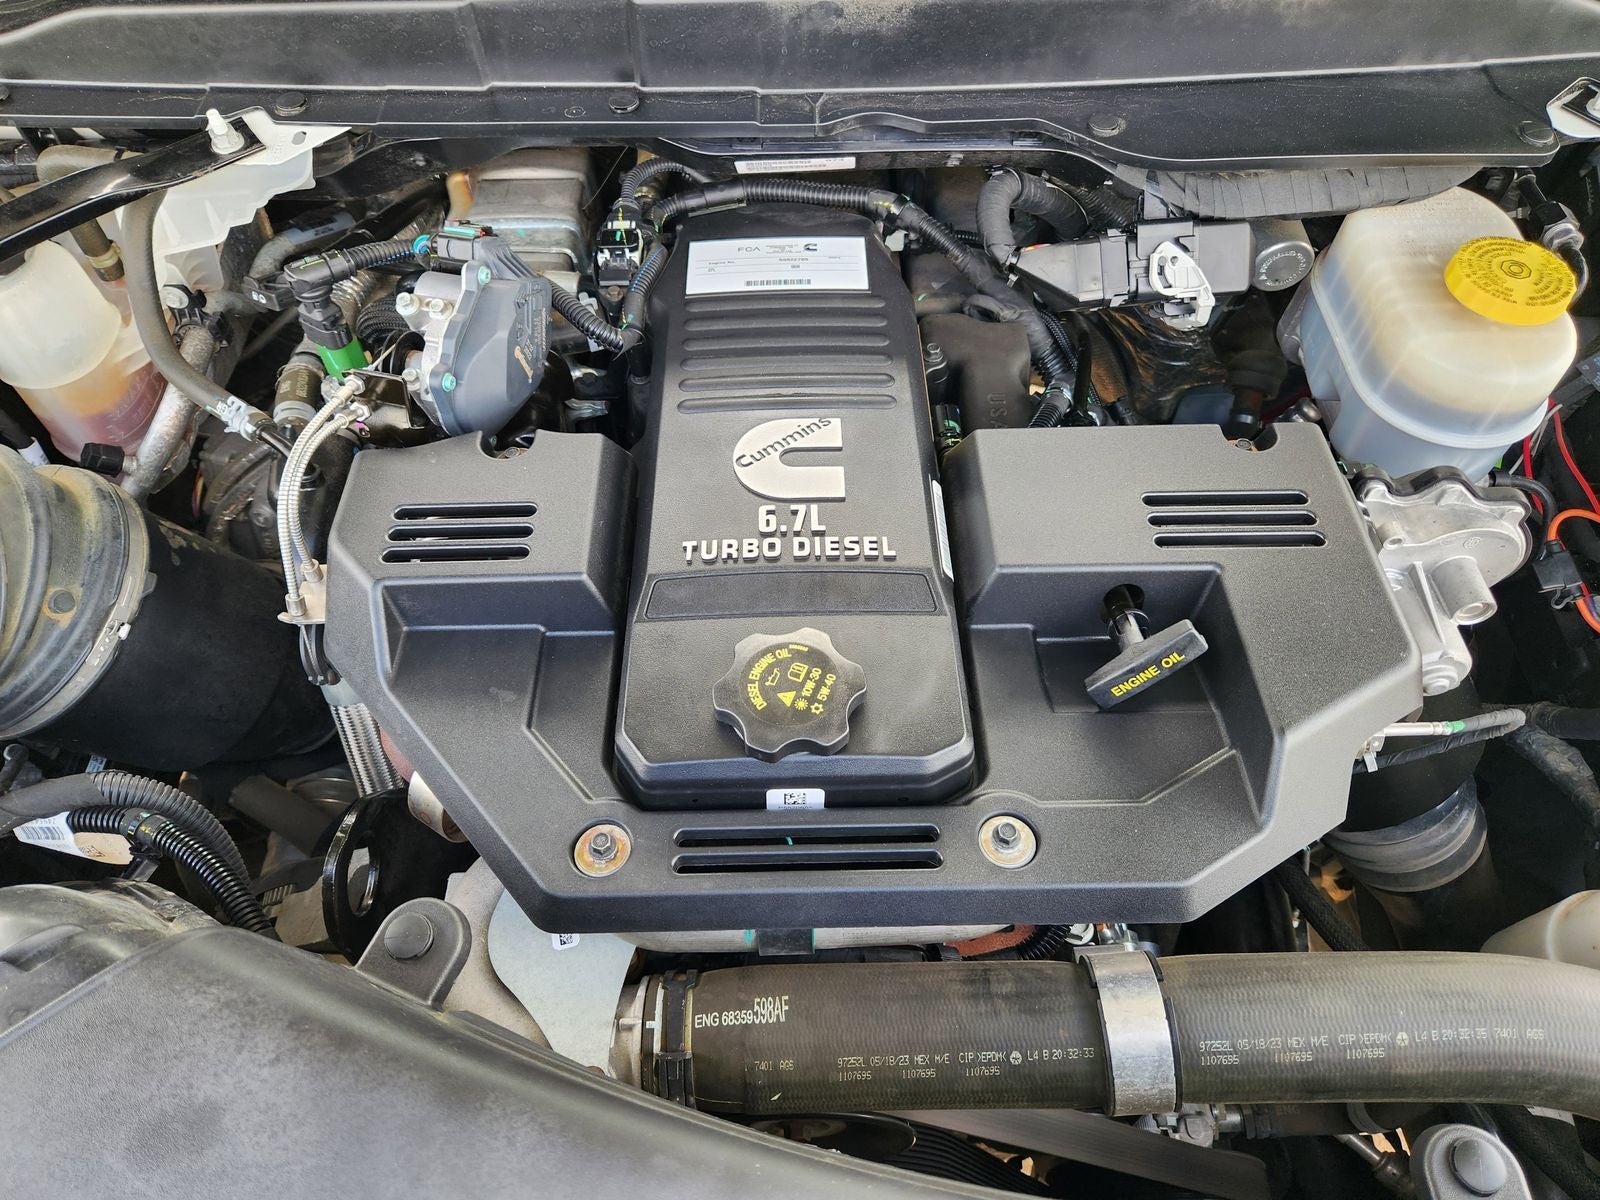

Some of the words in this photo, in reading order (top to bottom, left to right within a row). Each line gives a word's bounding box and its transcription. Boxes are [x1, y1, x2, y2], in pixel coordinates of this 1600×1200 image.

[735, 416, 832, 468] Cummins
[758, 504, 826, 535] 6.7L
[682, 537, 782, 564] TURBO
[793, 536, 897, 561] DIESEL
[748, 653, 776, 680] ENGINE
[775, 648, 792, 659] OIL
[802, 667, 822, 697] 10W-30
[816, 673, 837, 702] 5W-40
[1110, 665, 1161, 697] ENGINE
[1161, 651, 1185, 668] OIL
[747, 681, 767, 710] DIESEL
[694, 1012, 720, 1029] ENG
[1287, 1036, 1305, 1048] MEX
[1338, 1033, 1356, 1045] CIP
[1414, 1030, 1427, 1042] L4
[754, 1060, 773, 1072] 7401
[870, 1054, 909, 1067] 05/18/23
[914, 1054, 930, 1065] MEX
[934, 1053, 950, 1064] M/E
[959, 1051, 974, 1063] CIP
[1027, 1049, 1039, 1061] L4
[1052, 1047, 1095, 1060] 20:32:33
[1201, 1054, 1239, 1066] 1107695
[1346, 1047, 1385, 1060] 1107695
[839, 1070, 872, 1081] 1107695
[902, 1068, 936, 1079] 1107695
[966, 1065, 1001, 1076] 1107695
